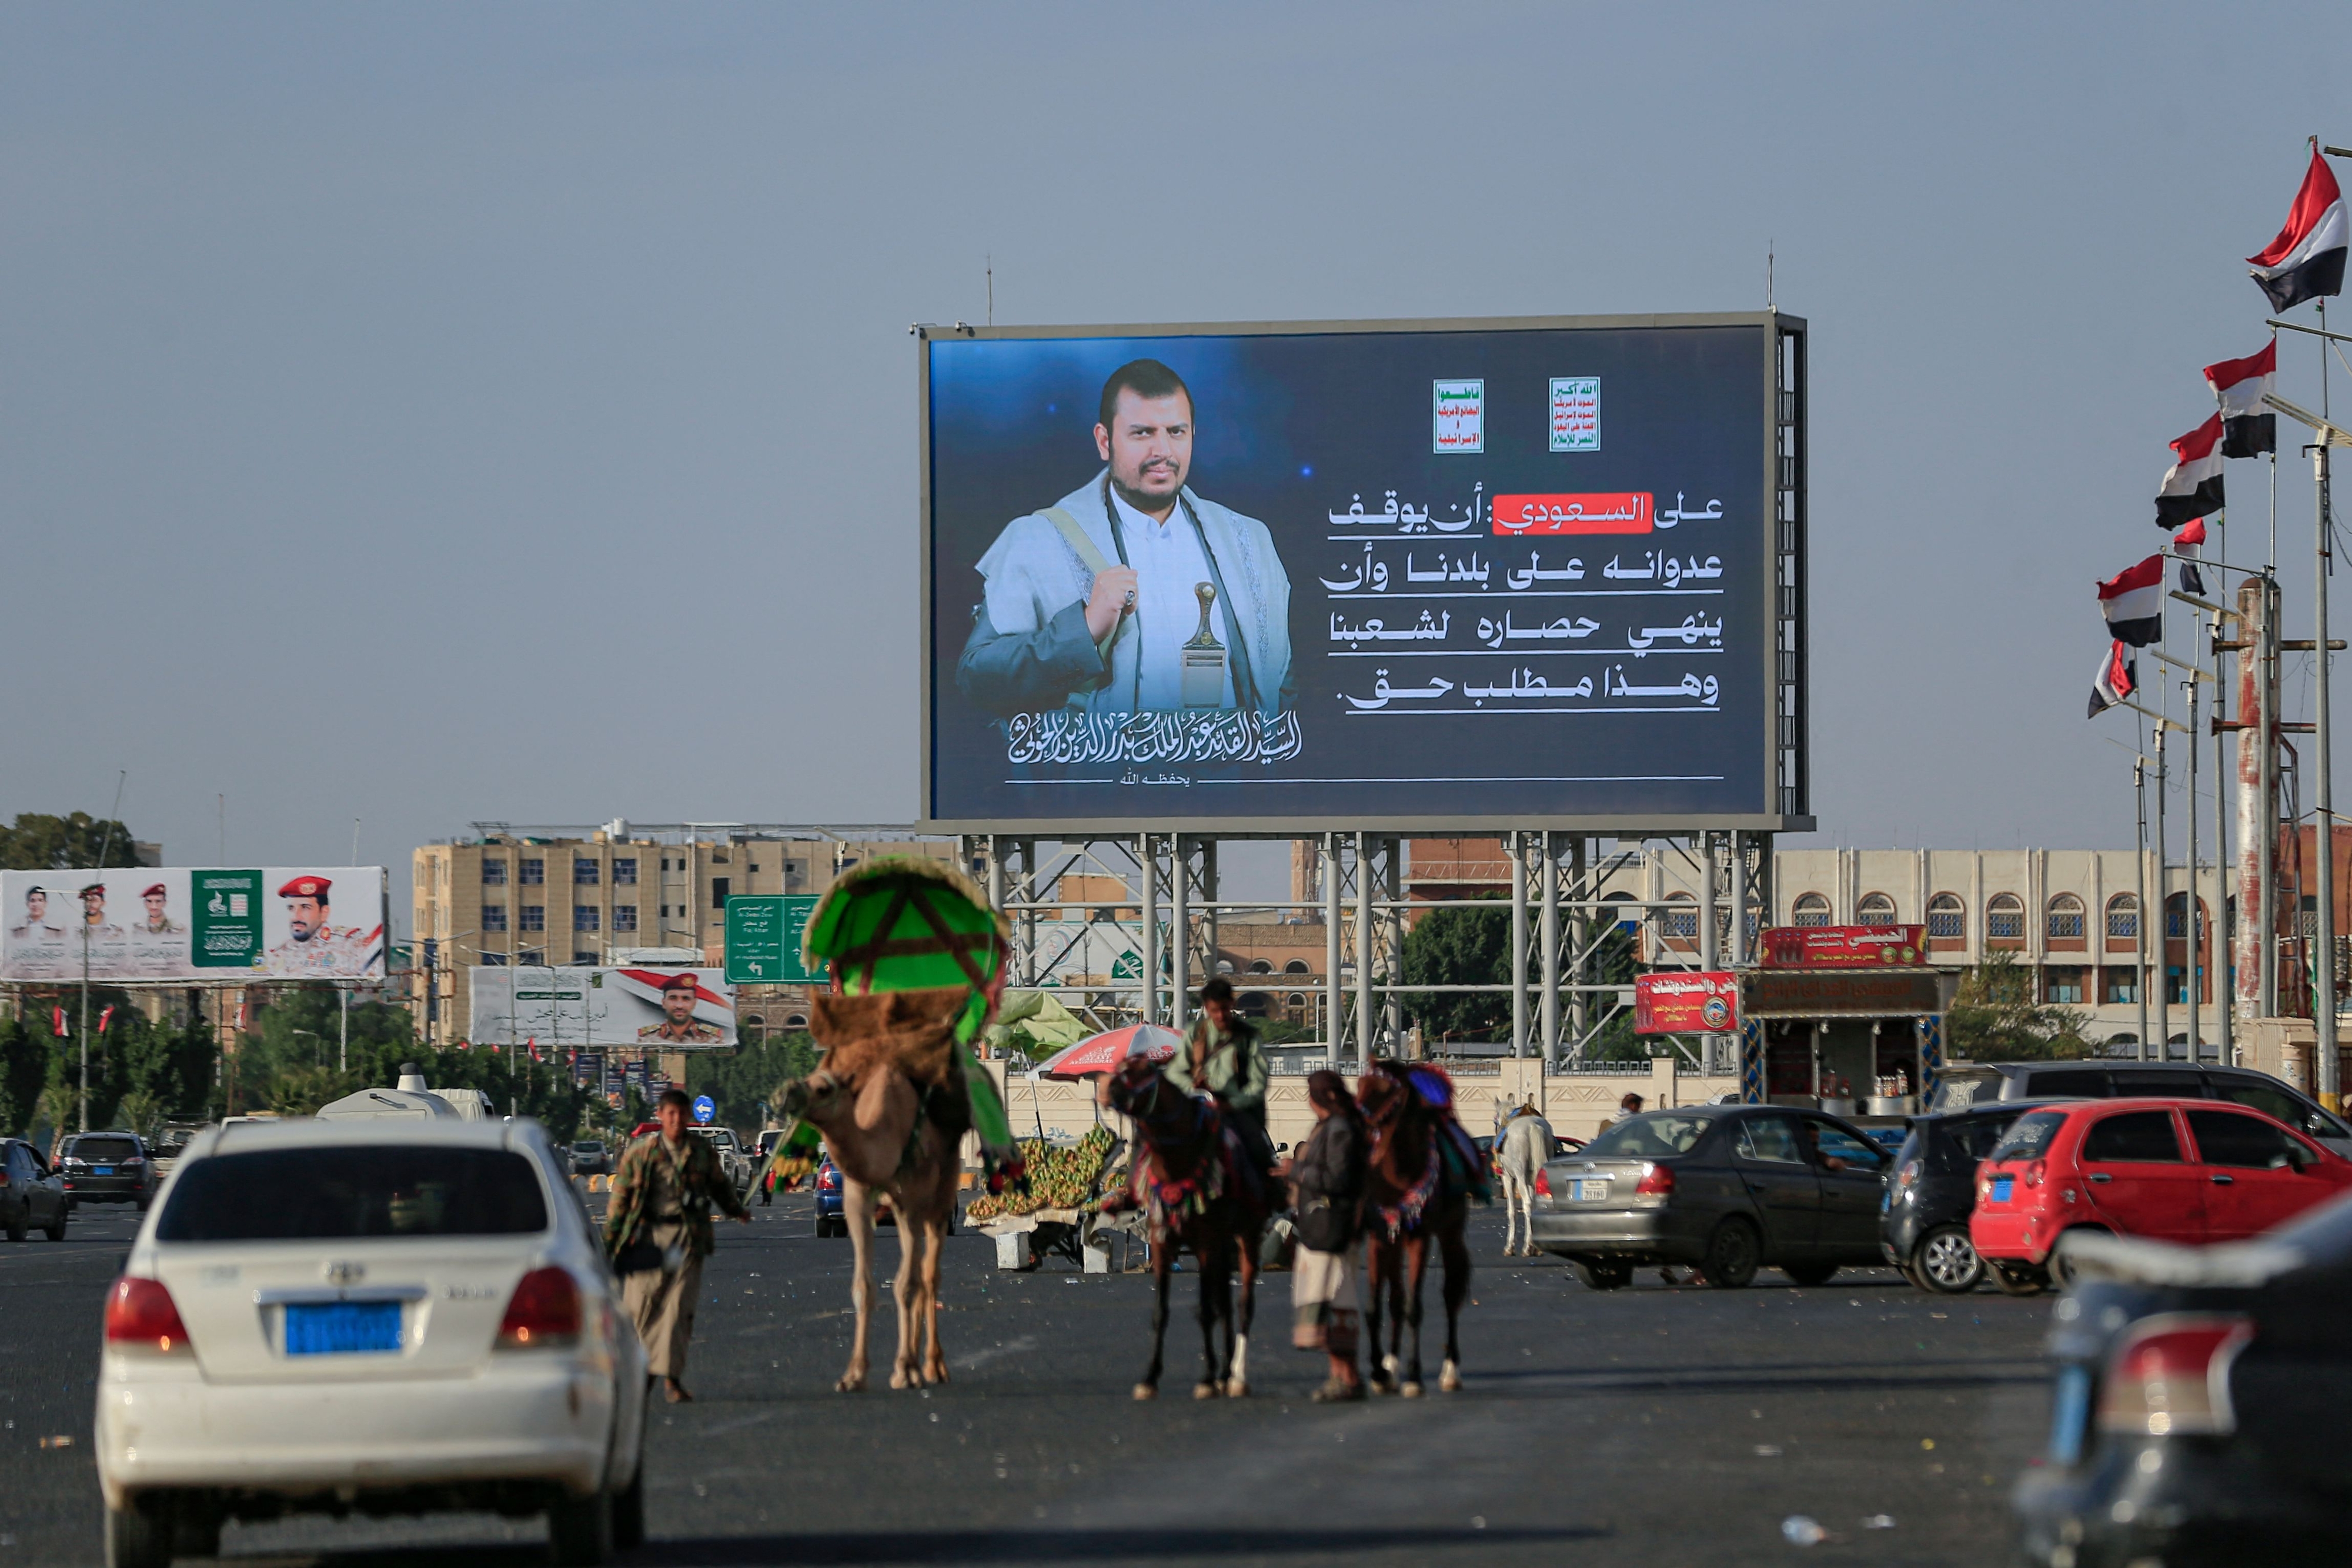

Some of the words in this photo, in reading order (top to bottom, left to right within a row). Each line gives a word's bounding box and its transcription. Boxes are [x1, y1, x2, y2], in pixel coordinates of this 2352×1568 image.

[1554, 380, 1579, 398] أكبر
[1581, 382, 1596, 394] الله
[1328, 489, 1430, 534] يوقف
[1429, 481, 1483, 529] أن
[1654, 490, 1723, 528] على
[1318, 540, 1389, 591] وأن
[1406, 550, 1491, 591] بلدنا
[1507, 550, 1585, 589] على
[1602, 548, 1723, 588] عدوانه
[1329, 609, 1451, 650] لشعبنا
[1476, 609, 1601, 648] حصاره
[1627, 610, 1723, 658] ينهي
[1462, 666, 1593, 707] مطلب
[1603, 663, 1719, 705] وهذا
[1120, 767, 1139, 785] الله
[1141, 773, 1190, 788] يحفظه
[1848, 928, 1908, 950] الحبيشي
